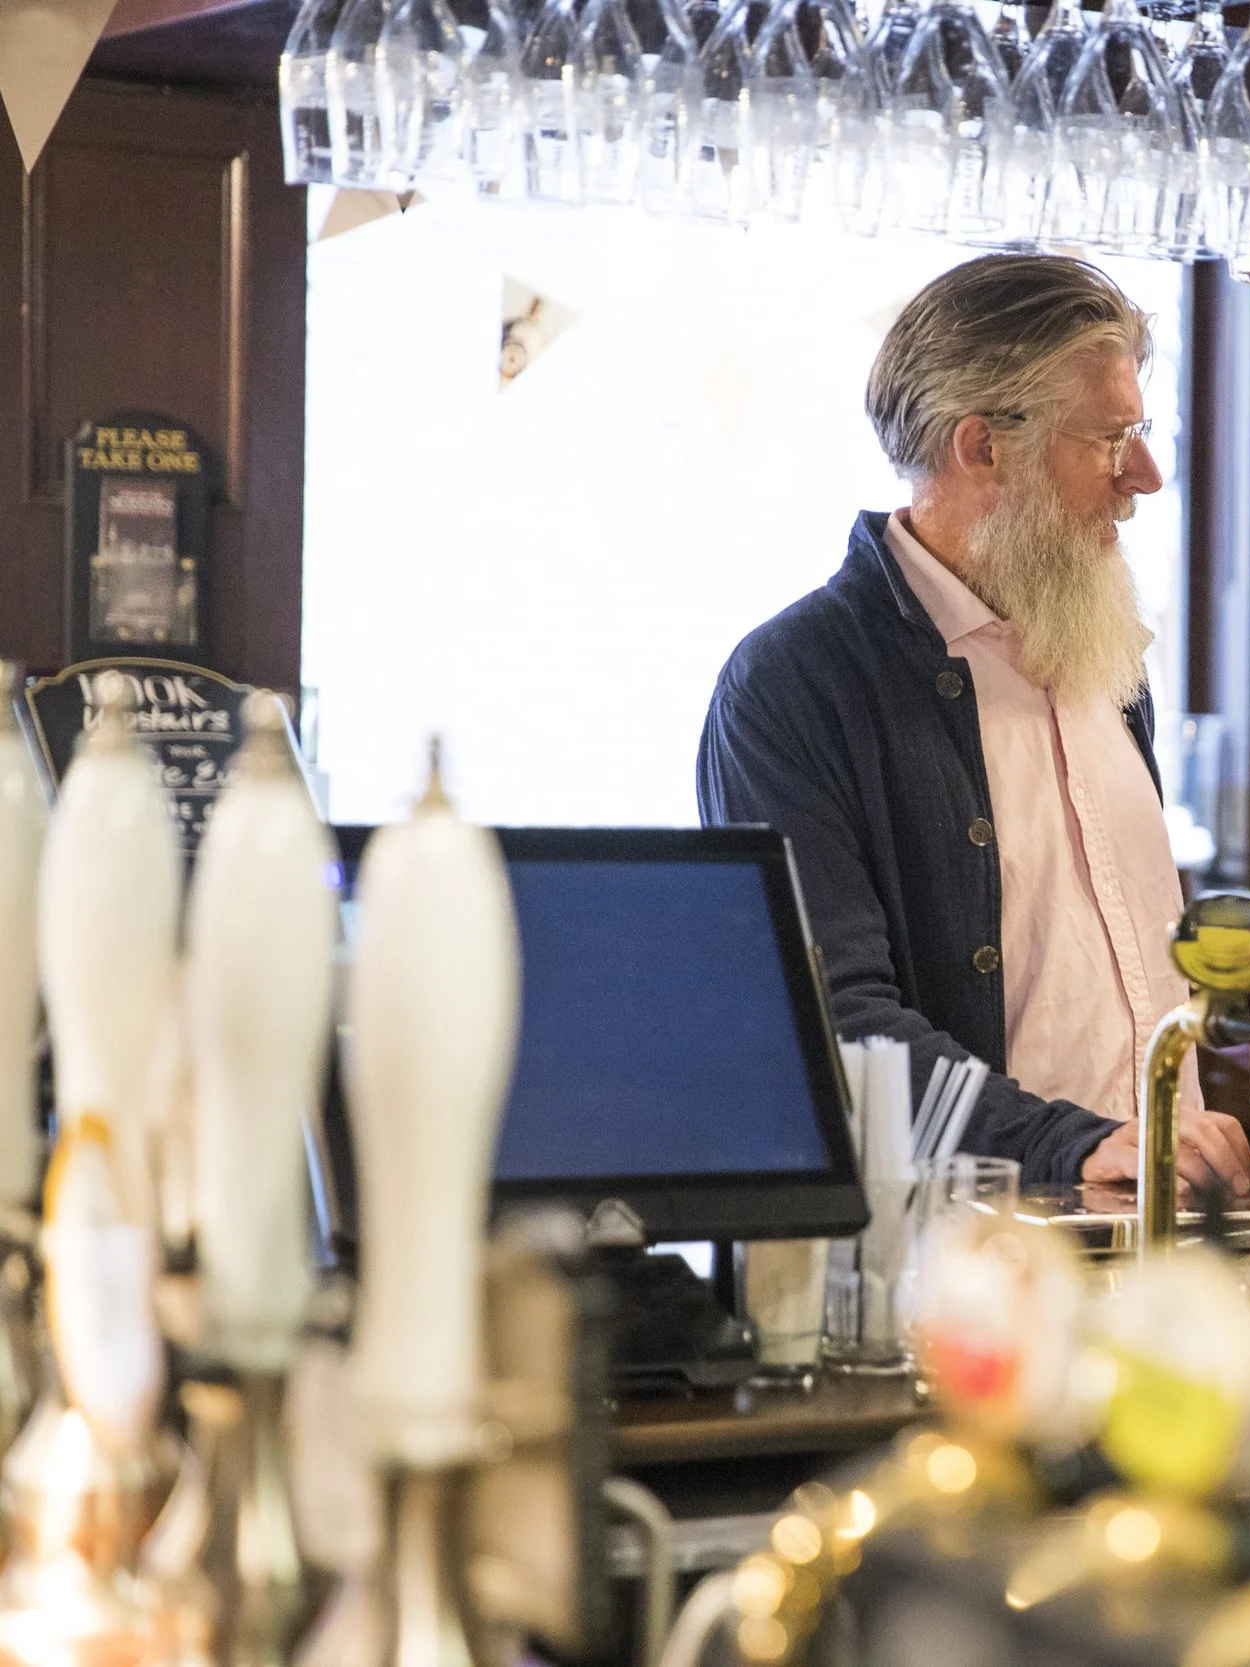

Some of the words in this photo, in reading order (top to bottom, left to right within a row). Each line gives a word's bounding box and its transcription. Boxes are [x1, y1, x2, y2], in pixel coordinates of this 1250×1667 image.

[96, 426, 187, 450] PLEASE
[79, 447, 141, 470] TAKE
[146, 450, 200, 473] ONE
[83, 703, 231, 736] Ustairs
